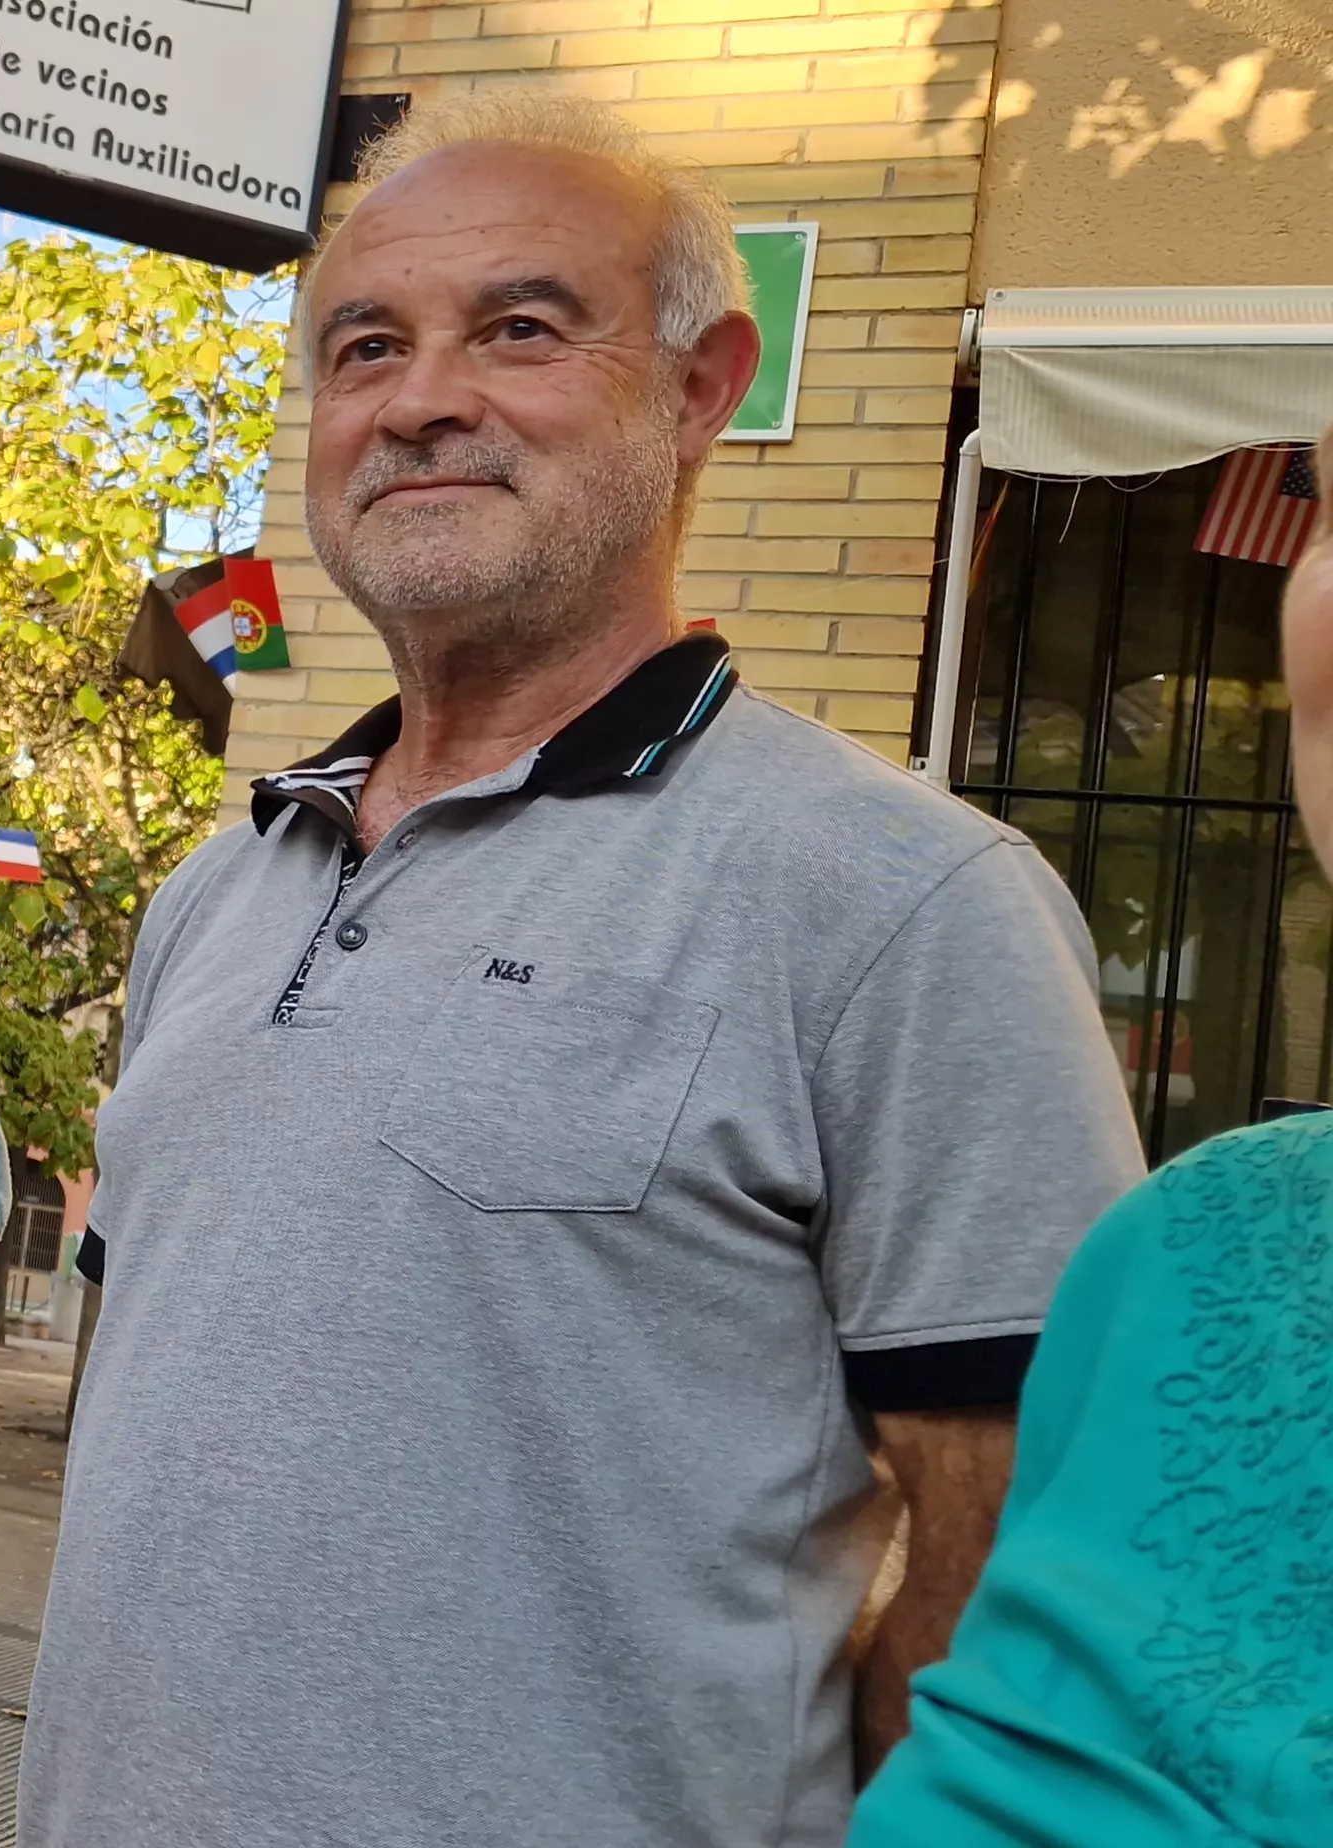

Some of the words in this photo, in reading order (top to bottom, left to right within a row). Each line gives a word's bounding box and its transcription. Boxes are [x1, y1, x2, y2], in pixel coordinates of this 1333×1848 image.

[37, 60, 169, 116] vecinos
[91, 127, 303, 211] Auxiliadora
[484, 958, 536, 985] N&S
